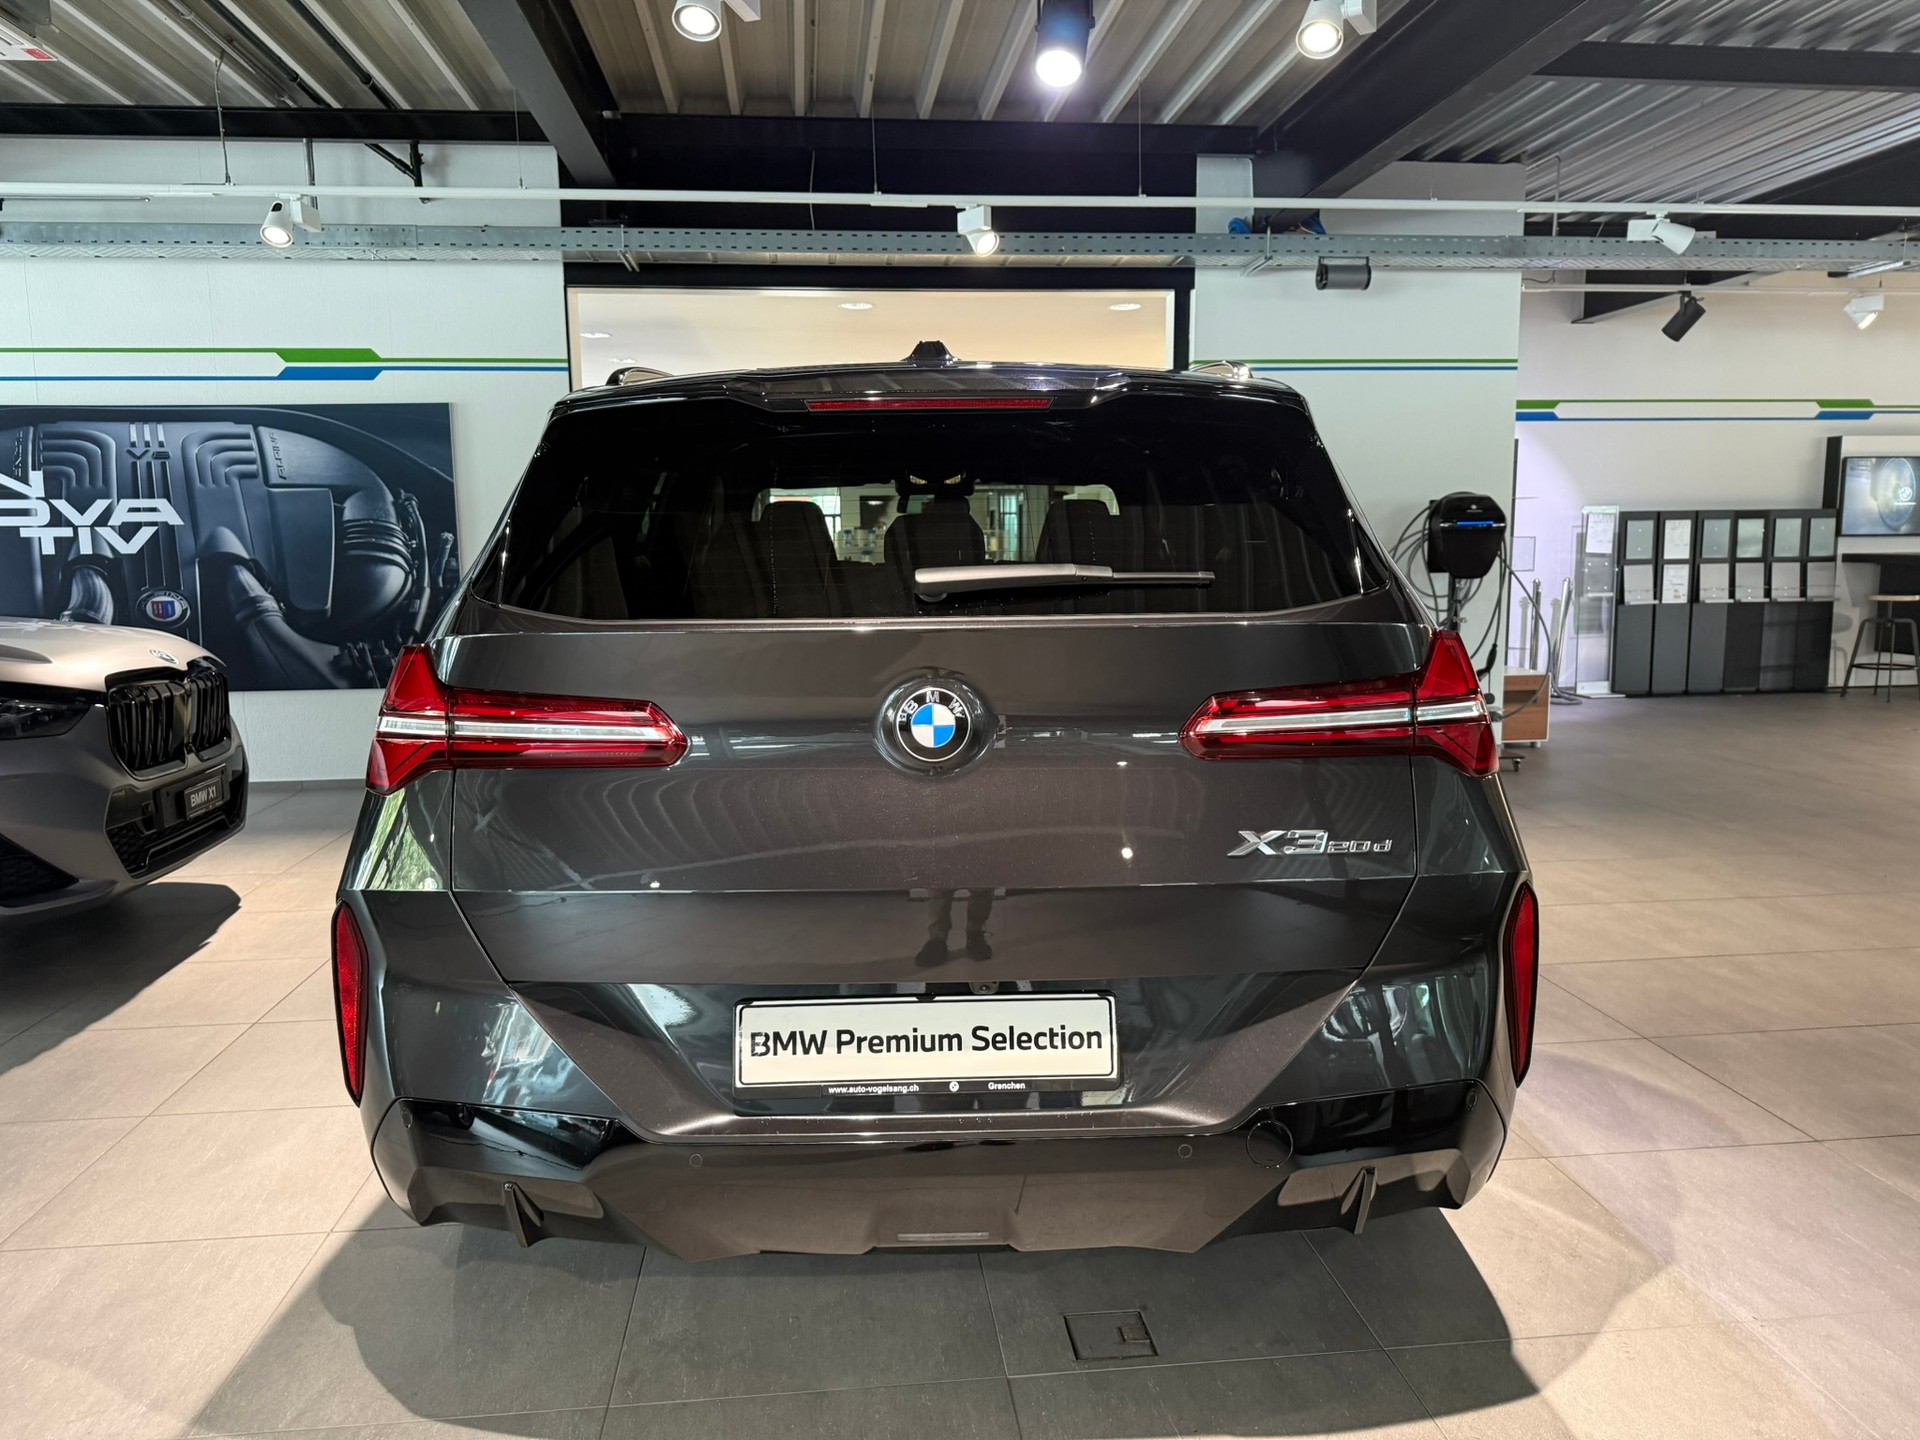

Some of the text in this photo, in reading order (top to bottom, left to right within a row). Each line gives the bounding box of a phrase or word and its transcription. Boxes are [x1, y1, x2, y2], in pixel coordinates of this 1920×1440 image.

[19, 526, 159, 555] TIV
[903, 691, 965, 718] BMW
[190, 785, 217, 807] BMW X1
[750, 1025, 1103, 1057] BMW Premium Selection
[828, 1082, 1026, 1095] www.auto-vogelsang.ch Grenchen
